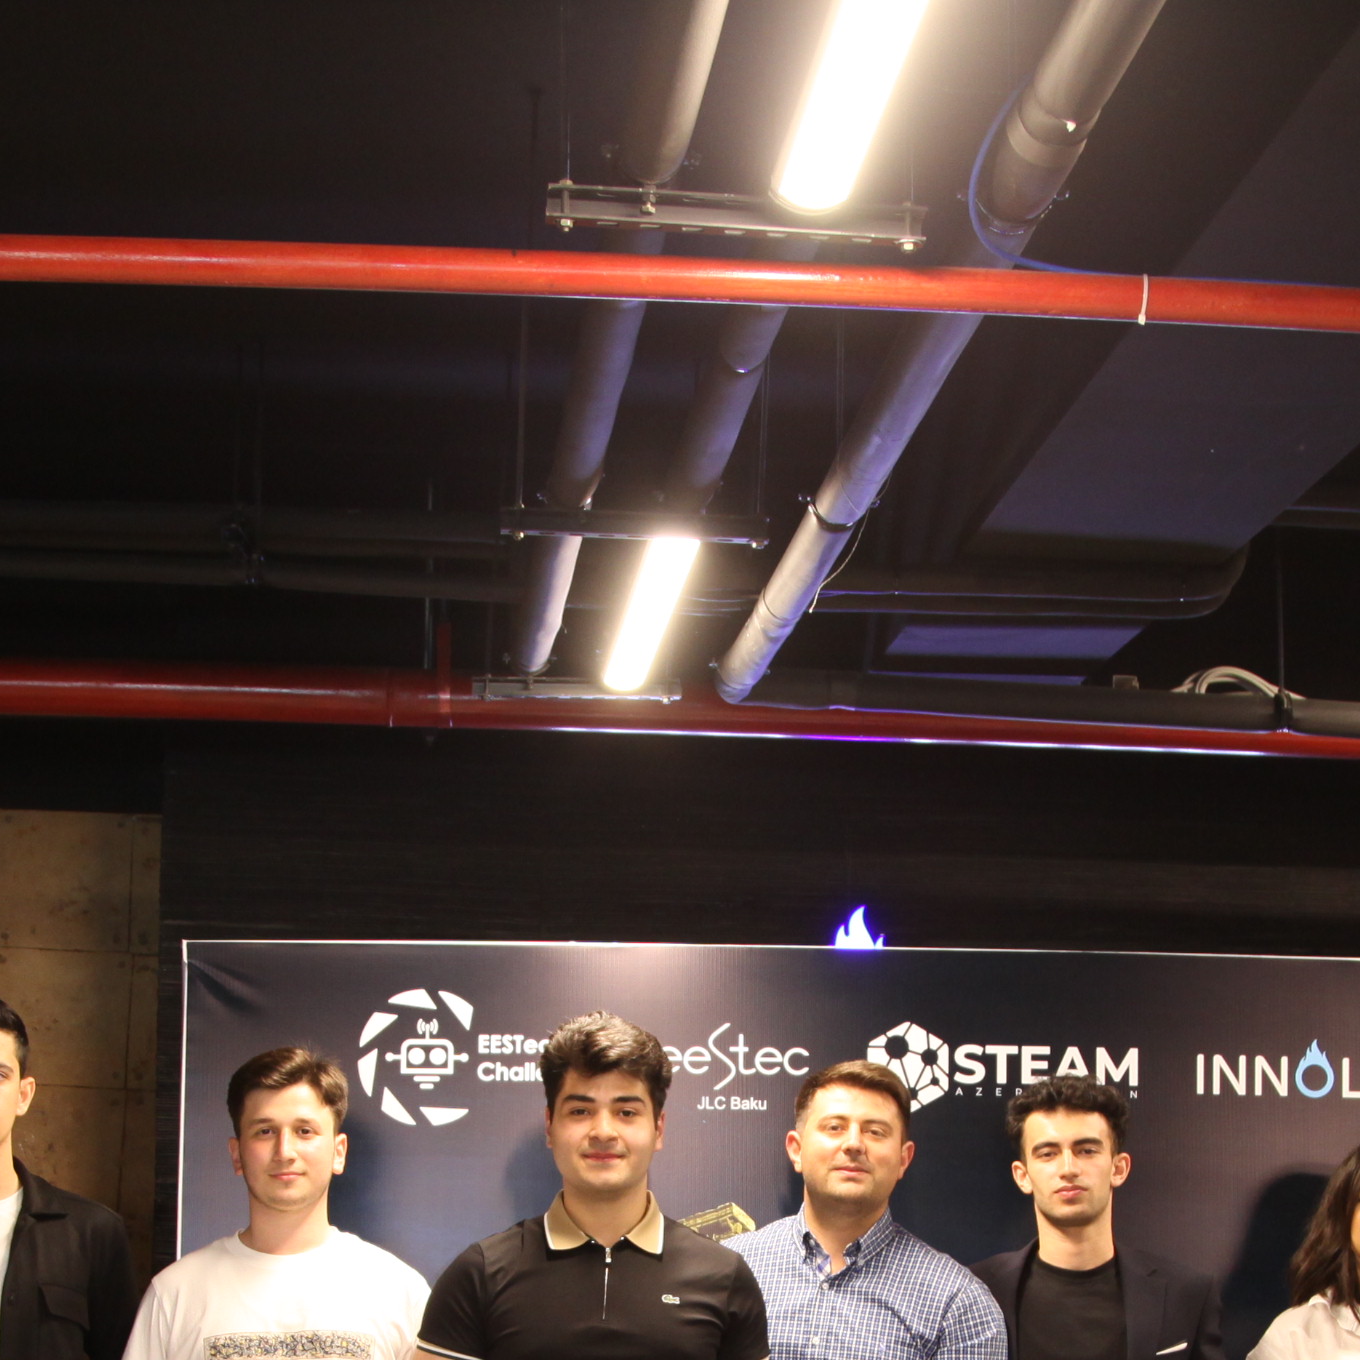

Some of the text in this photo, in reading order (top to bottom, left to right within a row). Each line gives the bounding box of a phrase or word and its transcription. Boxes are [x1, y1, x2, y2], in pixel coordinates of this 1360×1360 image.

[478, 1034, 550, 1055] EESTec
[953, 1043, 1139, 1087] STEAM
[696, 1095, 768, 1111] JLC Baku
